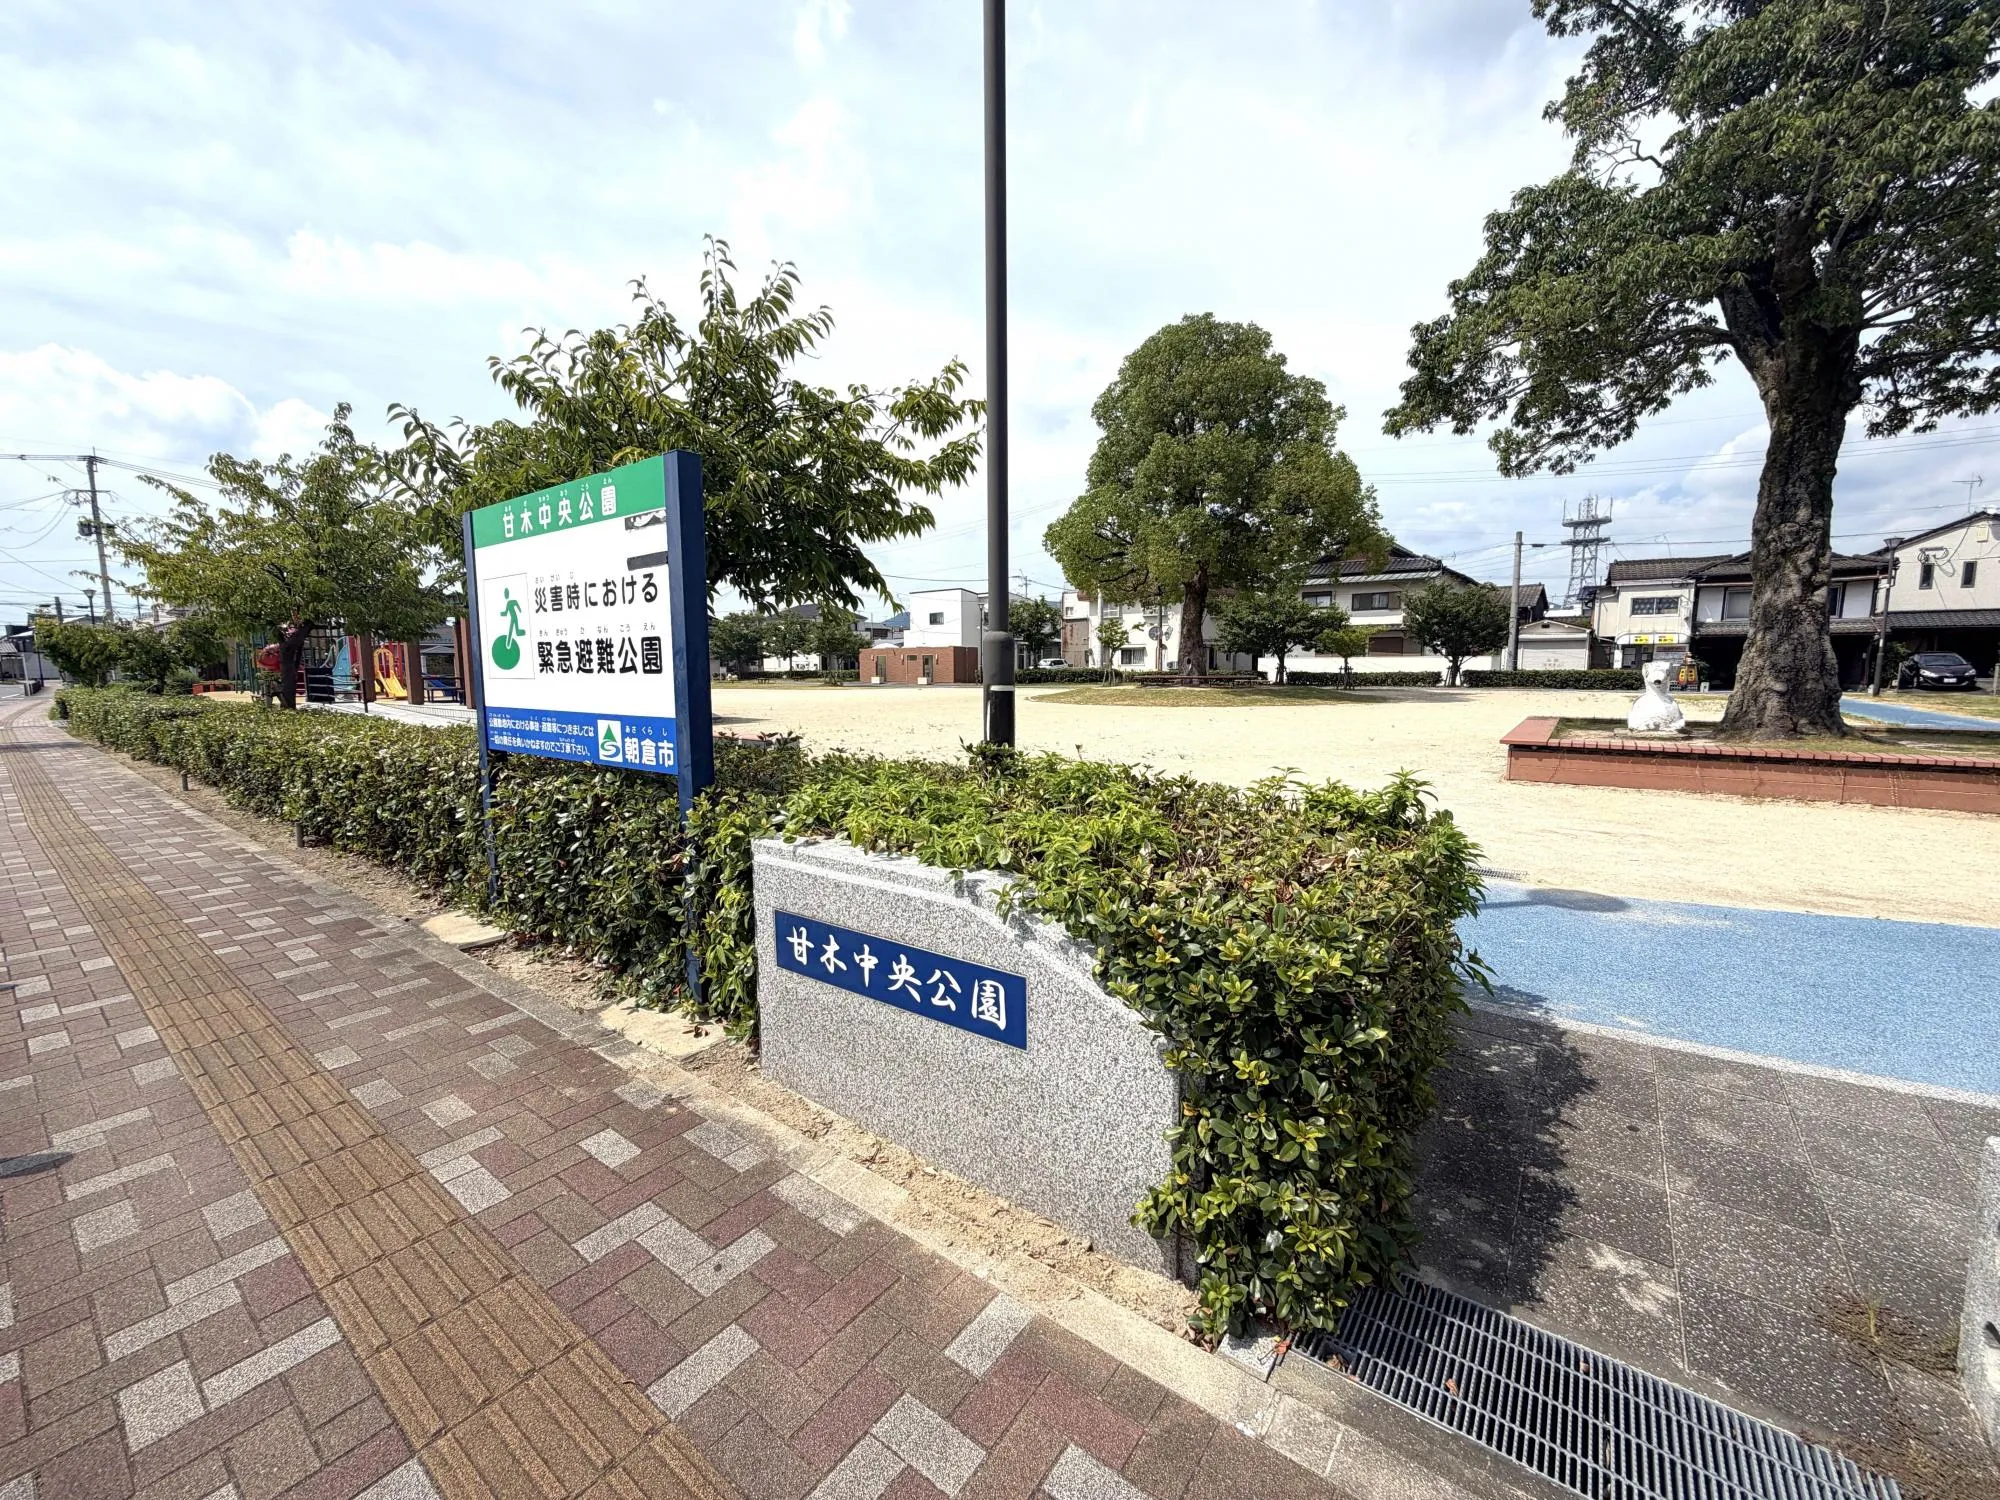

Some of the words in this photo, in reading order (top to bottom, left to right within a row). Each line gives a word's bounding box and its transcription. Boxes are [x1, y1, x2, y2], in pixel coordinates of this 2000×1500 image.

[502, 485, 617, 539] 甘木中央公園
[534, 572, 659, 614] 災害時における
[536, 635, 663, 675] 緊急避難公園
[624, 736, 674, 768] 朝倉市
[786, 926, 1007, 1031] 甘木中央公園
